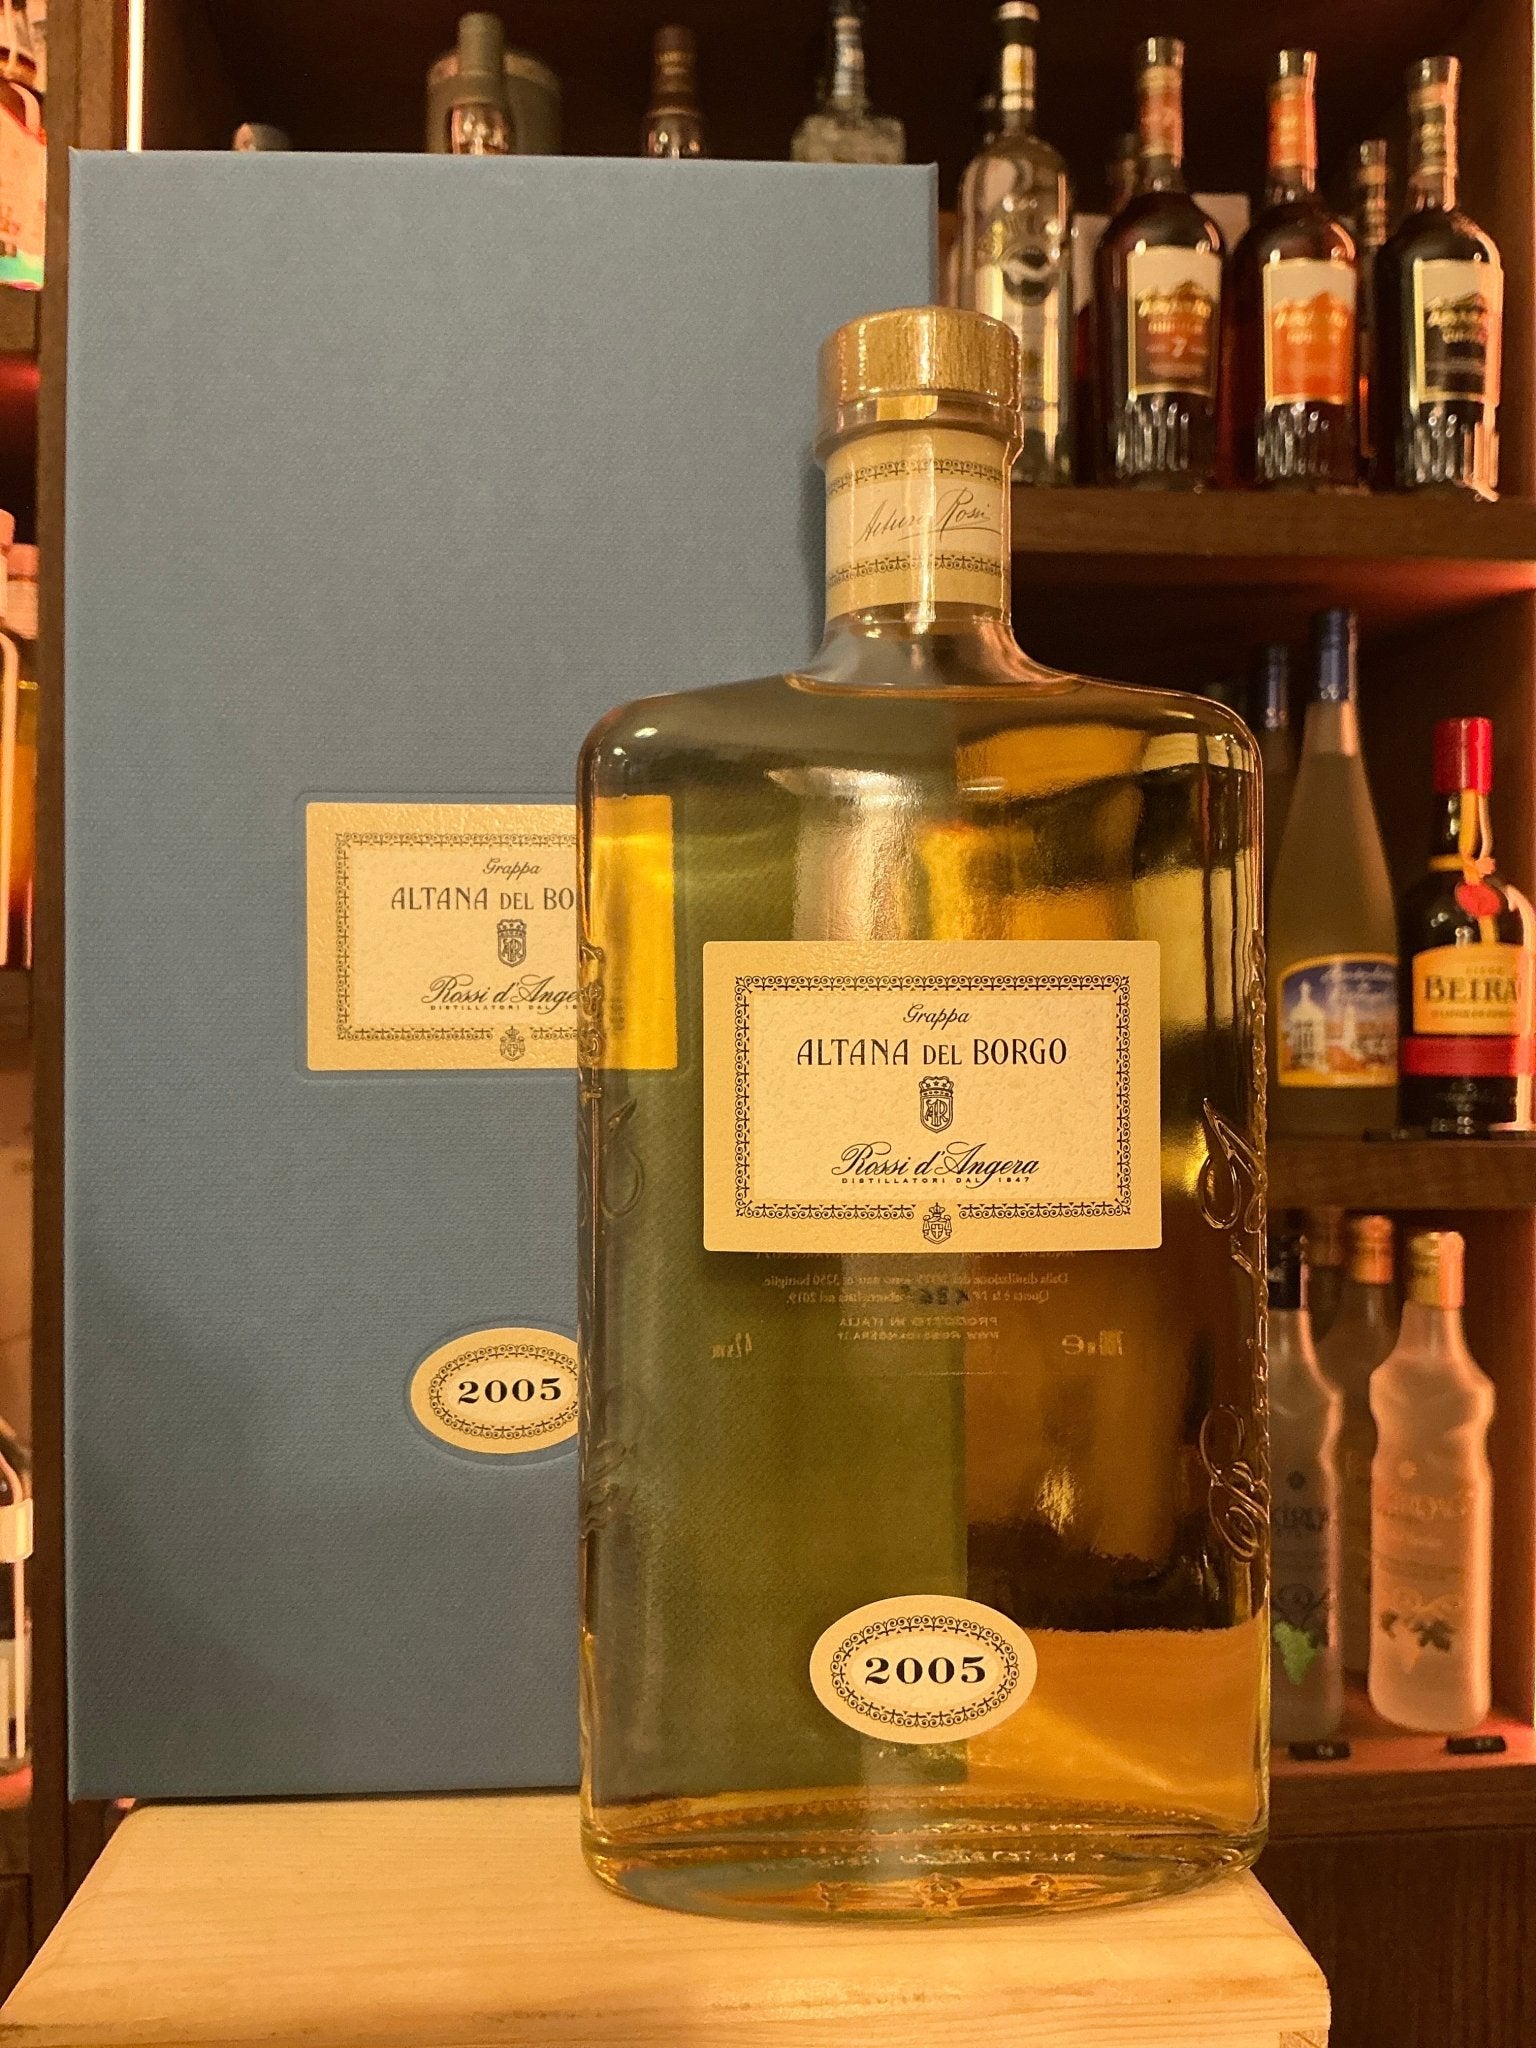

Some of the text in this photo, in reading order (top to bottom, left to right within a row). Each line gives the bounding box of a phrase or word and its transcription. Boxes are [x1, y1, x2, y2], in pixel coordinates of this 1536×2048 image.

[482, 856, 542, 881] Grappa
[391, 886, 575, 910] ALTANA DEL BO
[421, 973, 578, 1015] Rossi d'Ange
[902, 1003, 972, 1031] Grappa
[797, 1037, 1067, 1066] ALTANA DEL BORGO
[831, 1141, 1040, 1190] Rossi d'Angera
[458, 1377, 561, 1405] 2005
[865, 1656, 986, 1685] 2005
